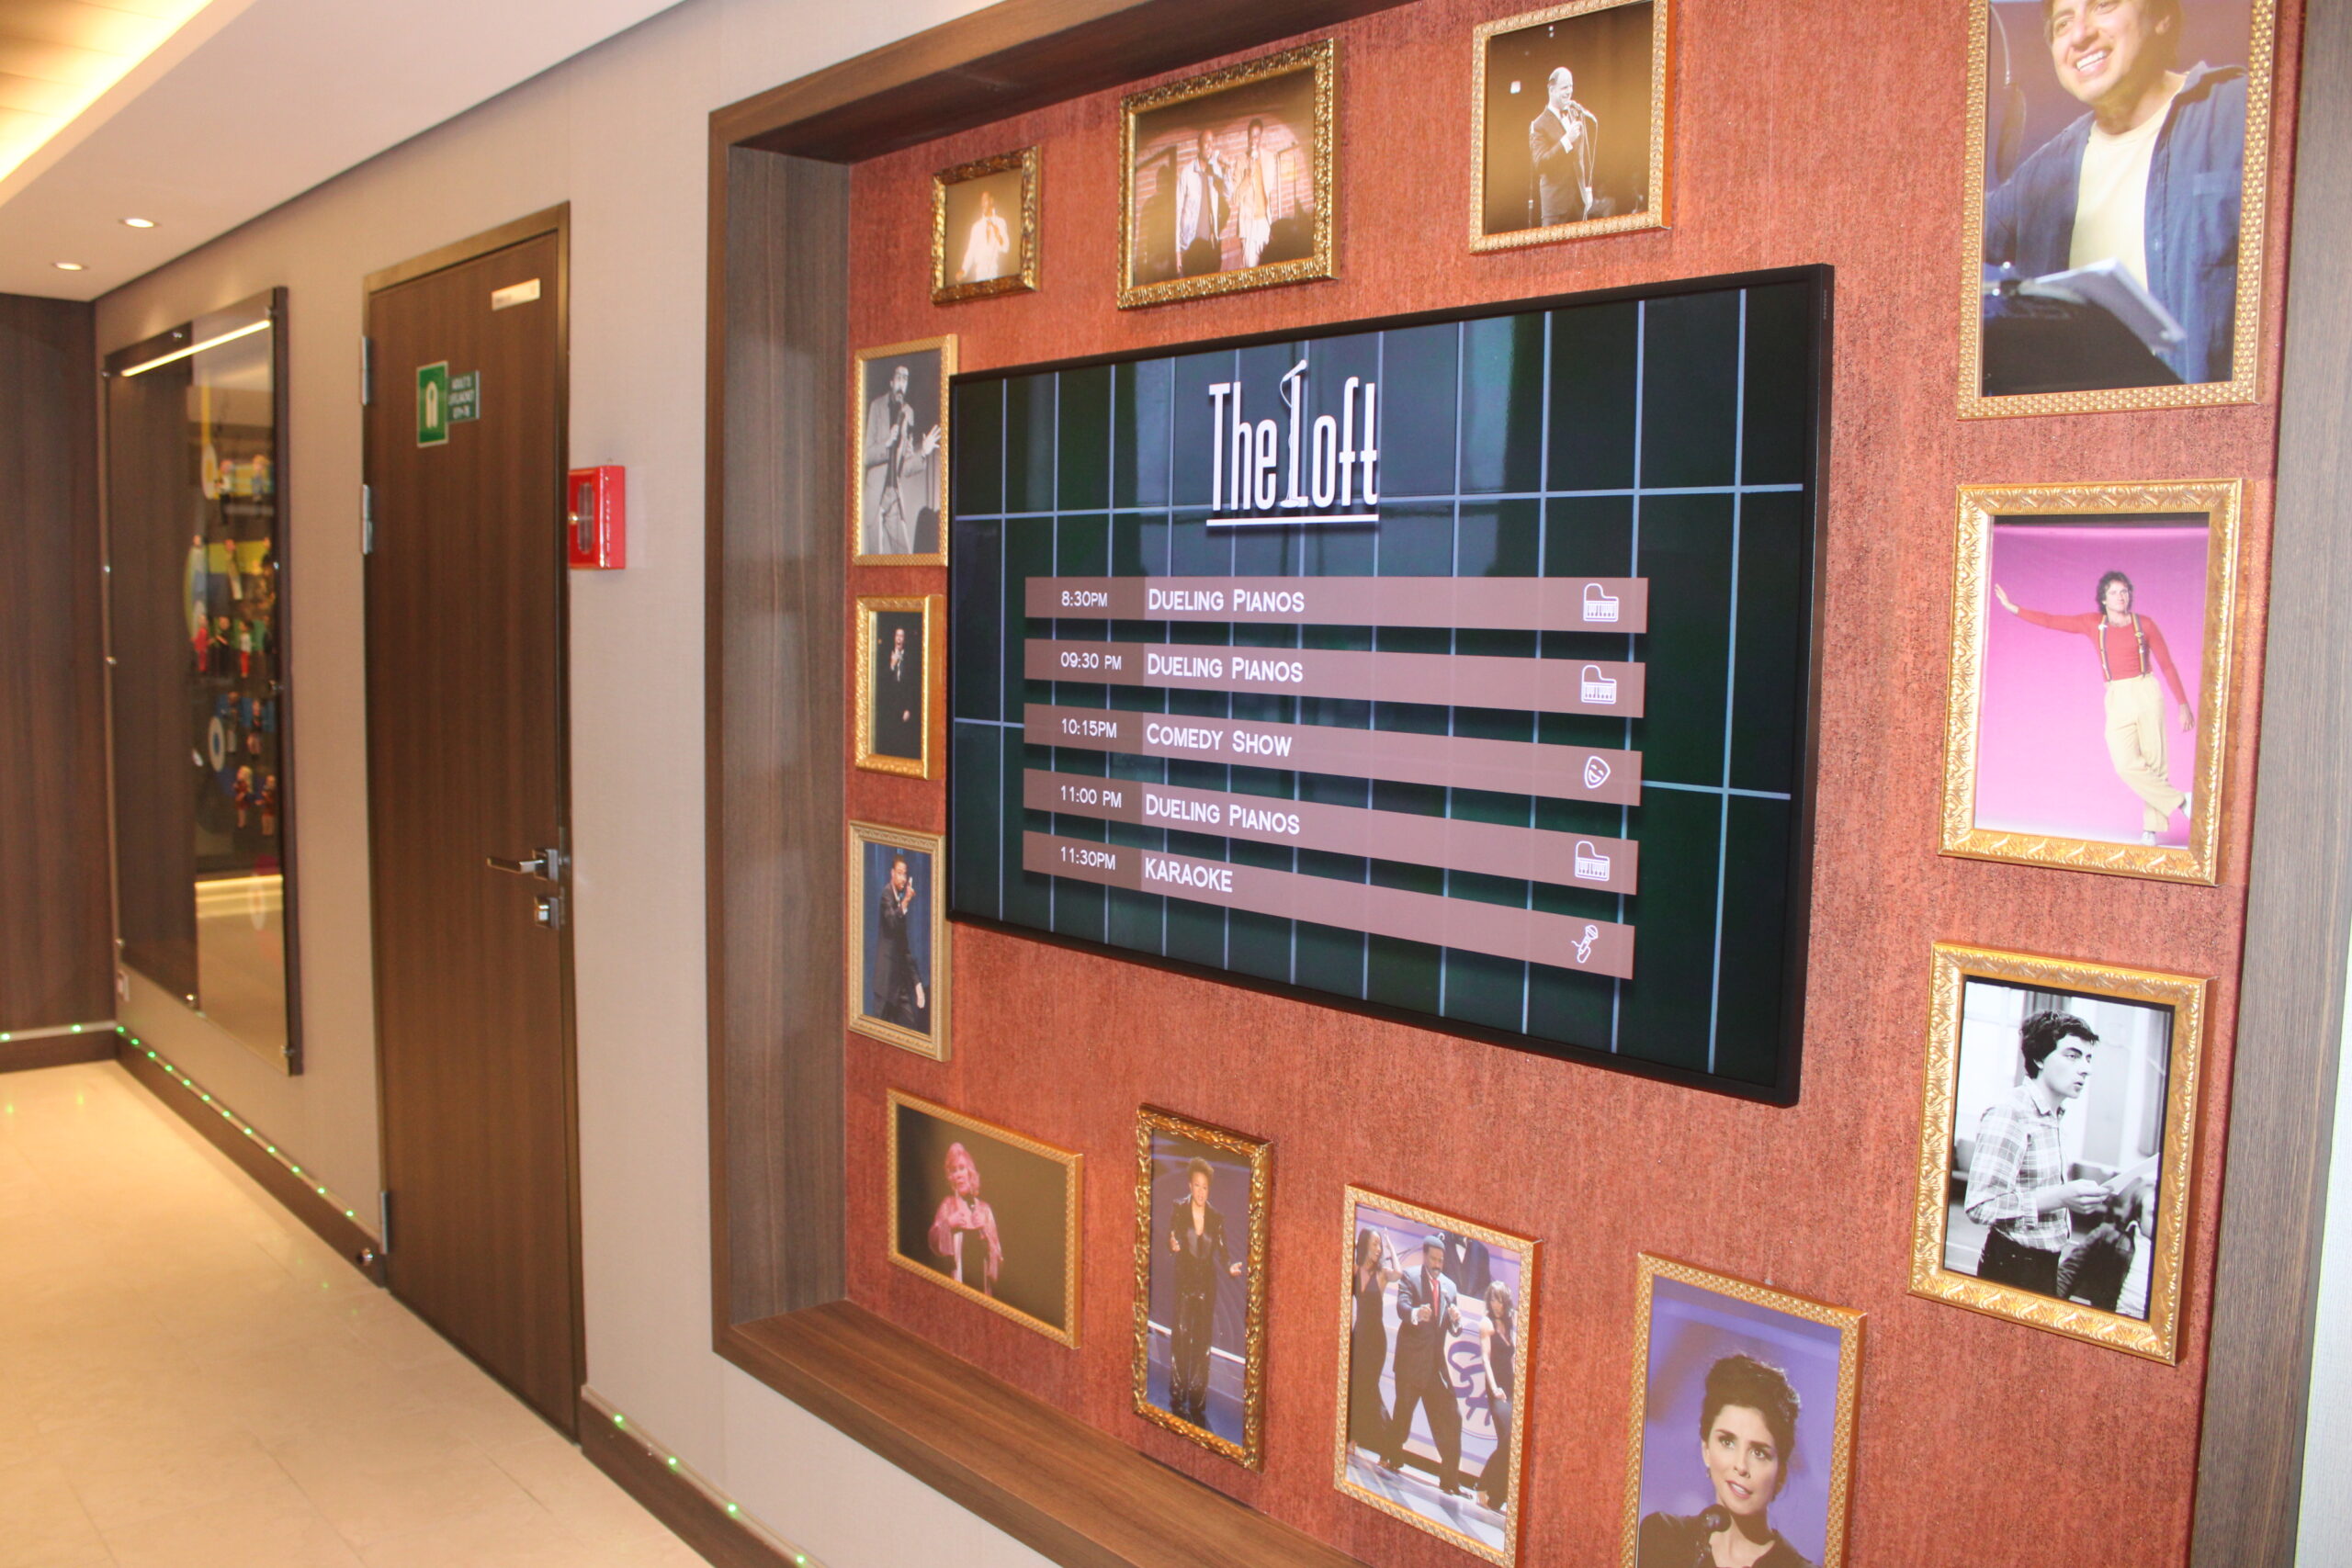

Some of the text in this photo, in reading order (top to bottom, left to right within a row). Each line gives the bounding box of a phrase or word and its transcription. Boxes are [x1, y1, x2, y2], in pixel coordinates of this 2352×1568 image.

[1209, 373, 1378, 511] The Loft
[1061, 591, 1108, 607] 8:30PM
[1148, 588, 1305, 613] DUELING PIANOS
[1060, 651, 1122, 671] 09:30 PM
[1148, 653, 1304, 682] DUELING PIANOS
[1061, 717, 1117, 739] 10:15PM
[1146, 723, 1292, 758] COMEDY SHOW
[1060, 785, 1122, 808] 11:00 PM
[1146, 794, 1300, 835] DUELING PIANOS
[1060, 846, 1116, 870] 11:30PM
[1145, 857, 1233, 893] KARAOKE
